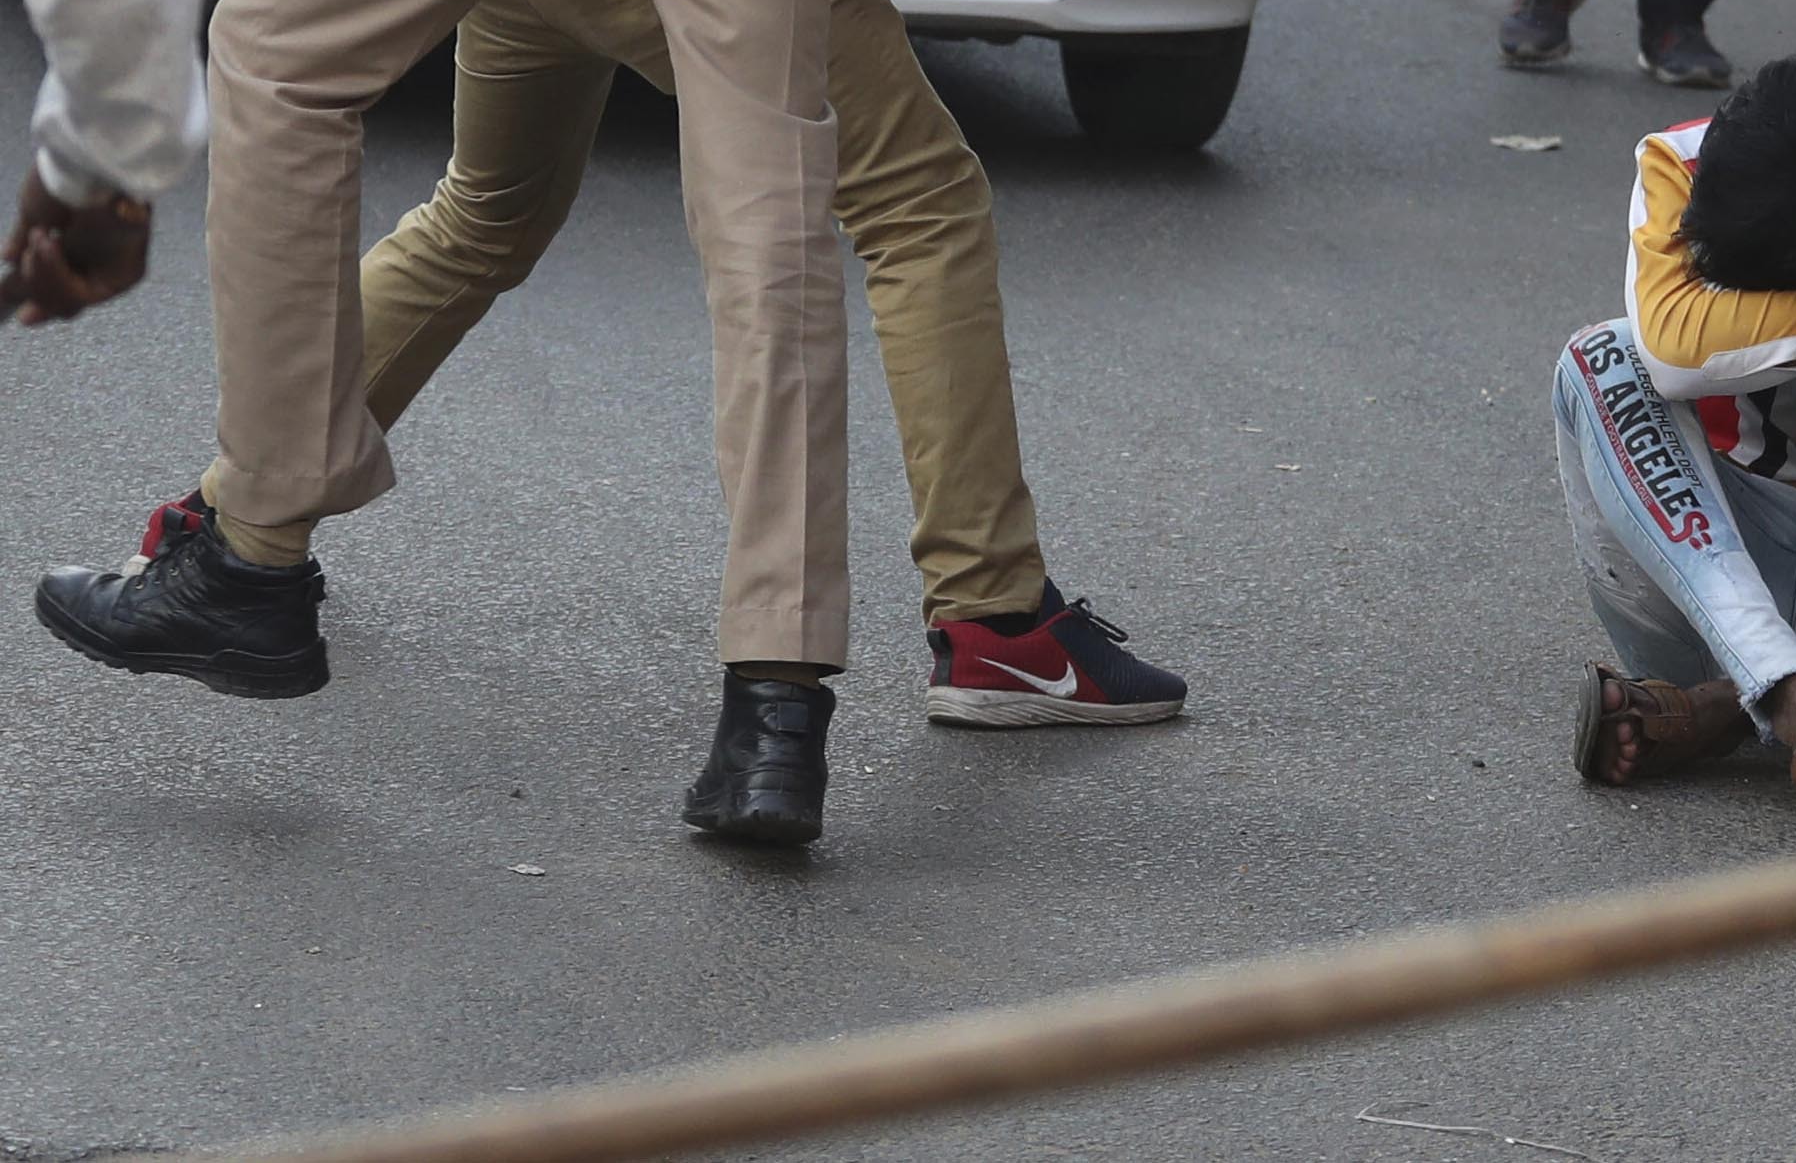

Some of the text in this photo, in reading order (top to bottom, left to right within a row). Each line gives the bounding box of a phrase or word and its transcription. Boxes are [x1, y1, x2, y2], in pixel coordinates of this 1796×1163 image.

[1603, 416, 1635, 467] FOOTBALL
[1624, 464, 1654, 508] LEAGUE
[1648, 399, 1686, 458] ATHLETIC
